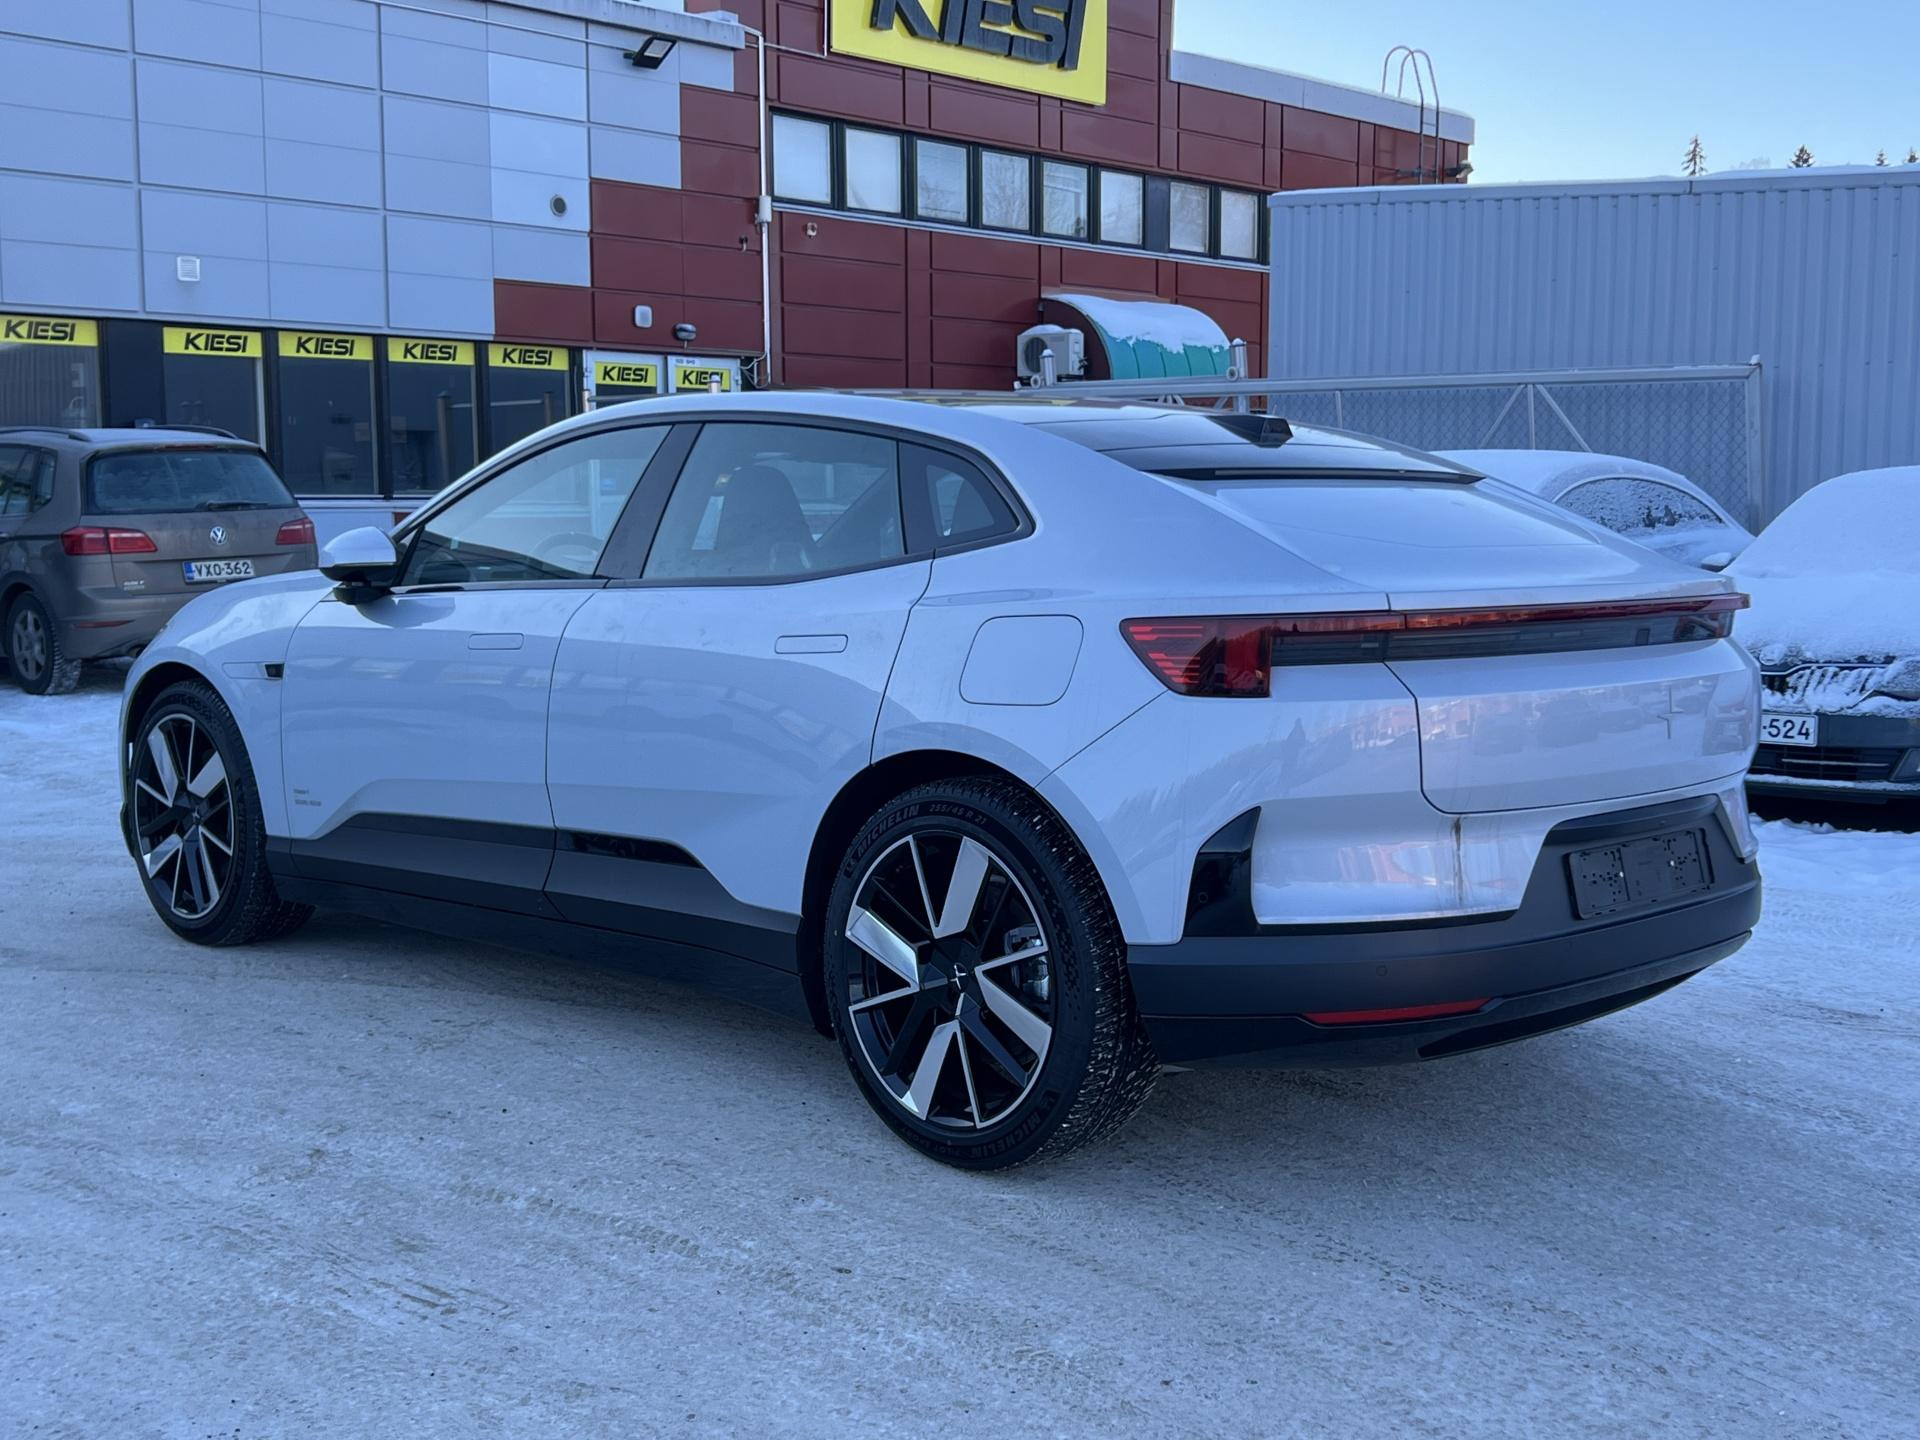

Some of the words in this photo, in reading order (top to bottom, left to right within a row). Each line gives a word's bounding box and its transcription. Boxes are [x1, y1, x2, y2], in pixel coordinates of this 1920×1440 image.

[4, 319, 76, 342] KIESI
[184, 332, 248, 353] KIESI
[296, 336, 355, 356] KIESI
[403, 342, 457, 362] KIESI
[502, 347, 552, 366] KIESI
[602, 365, 648, 383] KIESI
[195, 561, 251, 578] VXO-362
[858, 804, 920, 858] MICHELIN
